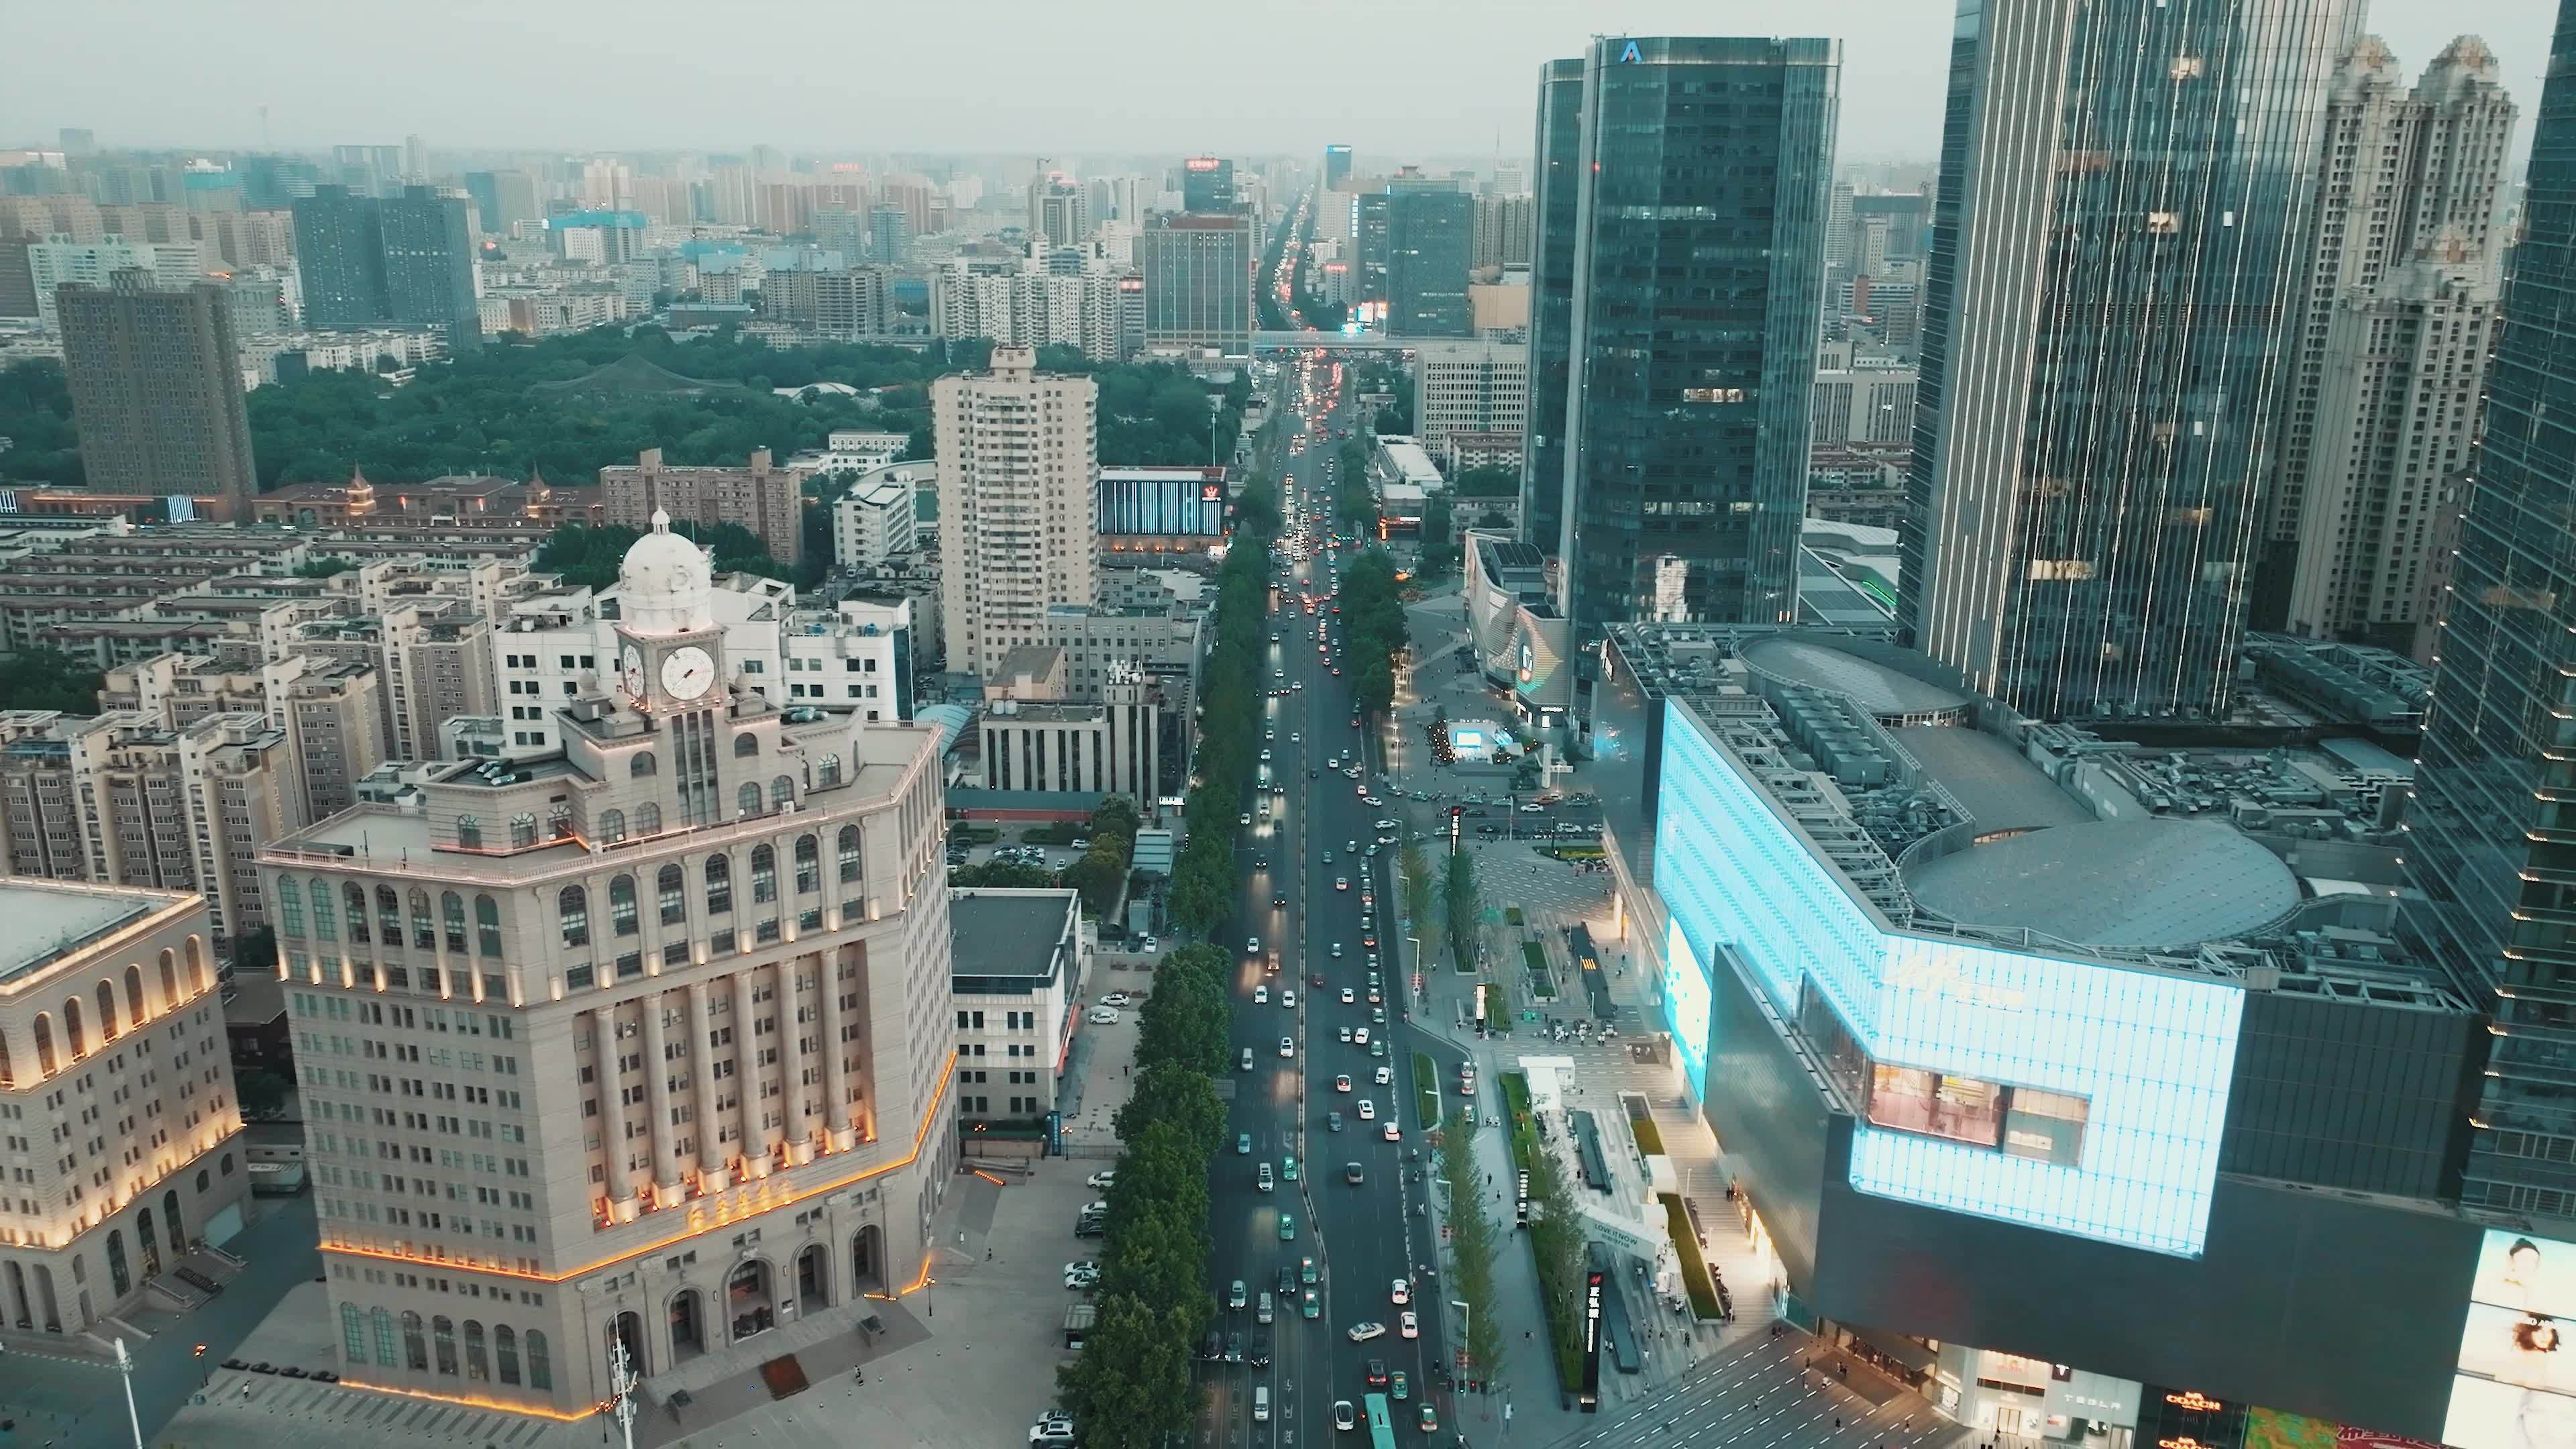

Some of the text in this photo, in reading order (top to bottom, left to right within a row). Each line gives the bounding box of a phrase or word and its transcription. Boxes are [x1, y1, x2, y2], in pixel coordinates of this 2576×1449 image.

[1595, 1223, 1611, 1235] LOVE
[2063, 1393, 2121, 1411] TESLA
[2165, 1394, 2222, 1411] COACH
